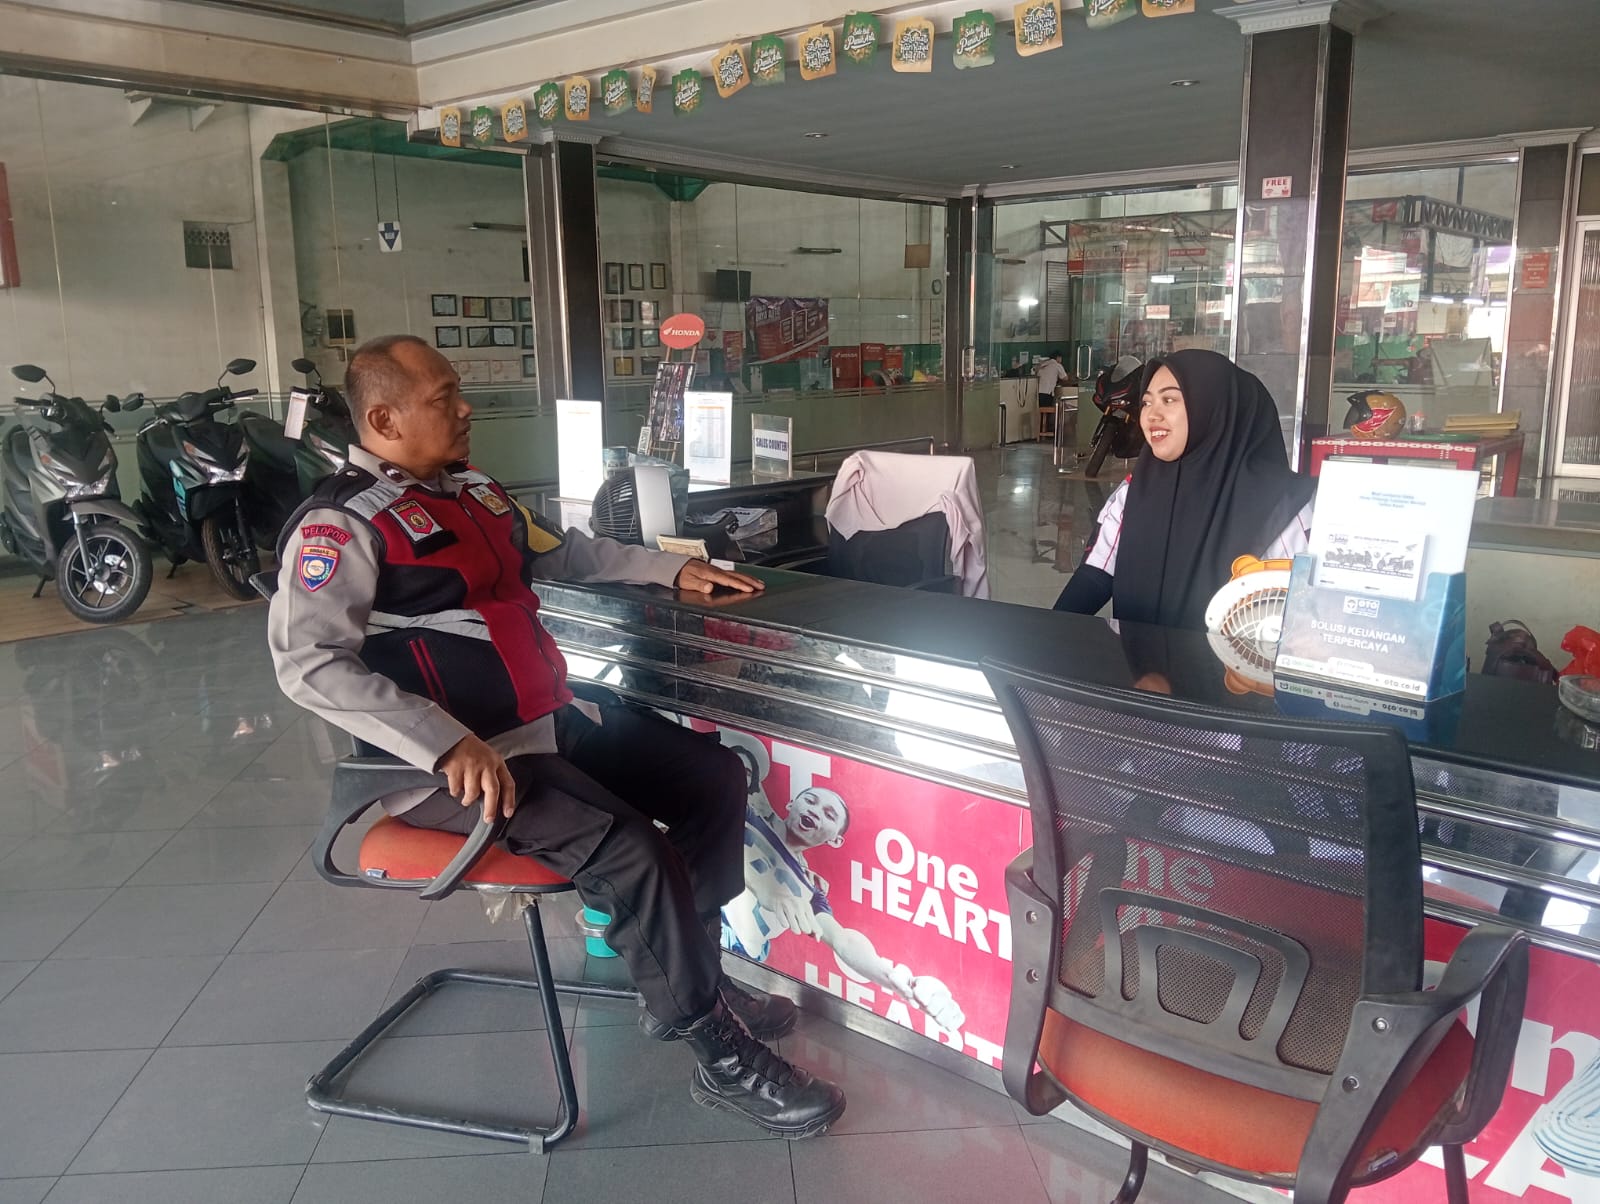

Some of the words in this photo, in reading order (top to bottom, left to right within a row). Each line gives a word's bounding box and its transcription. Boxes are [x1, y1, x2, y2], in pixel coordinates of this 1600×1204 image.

[1265, 178, 1288, 187] FREE
[671, 328, 700, 337] HONDA
[755, 436, 769, 448] SALES
[768, 438, 788, 452] COUNTER
[304, 527, 346, 543] PELOPOR
[1311, 619, 1346, 634] SOLUSI
[1347, 624, 1406, 644] KEUANGAN
[1322, 633, 1389, 653] TERPERCAYA
[1384, 679, 1421, 692] oto.co.id
[875, 828, 980, 900] One
[850, 859, 1014, 962] HEART
